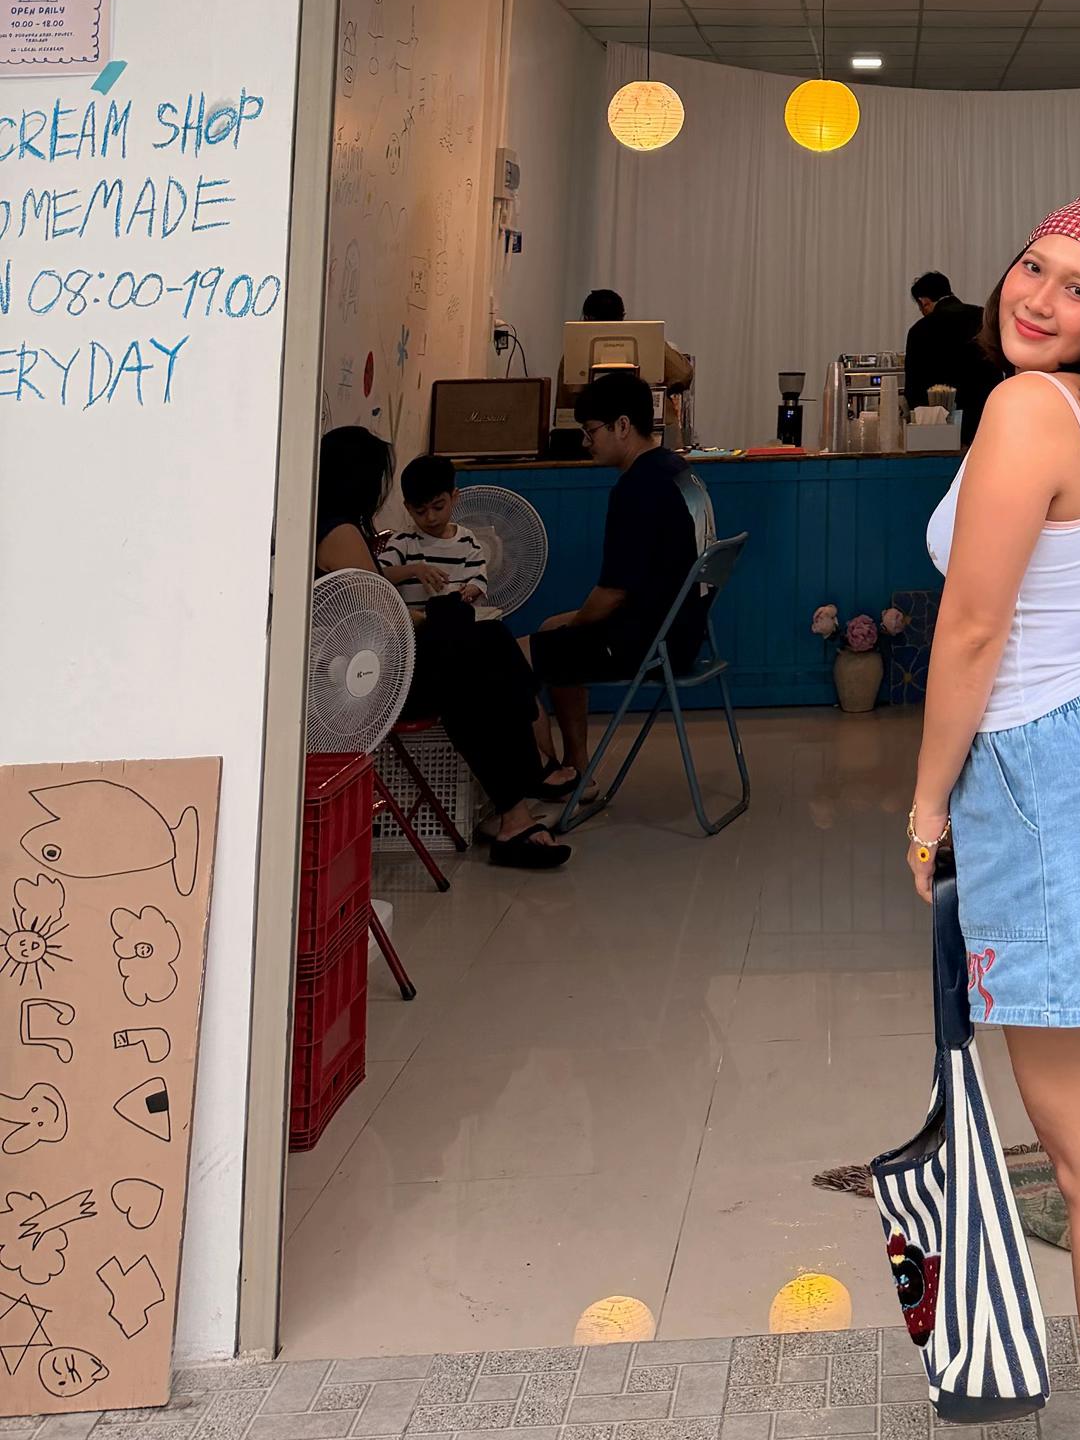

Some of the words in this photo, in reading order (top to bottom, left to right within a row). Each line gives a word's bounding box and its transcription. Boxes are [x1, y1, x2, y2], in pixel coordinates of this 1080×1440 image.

[10, 6, 36, 15] OPEN
[38, 6, 65, 14] DAILY
[0, 98, 132, 162] CREAM
[152, 86, 264, 159] SHOP
